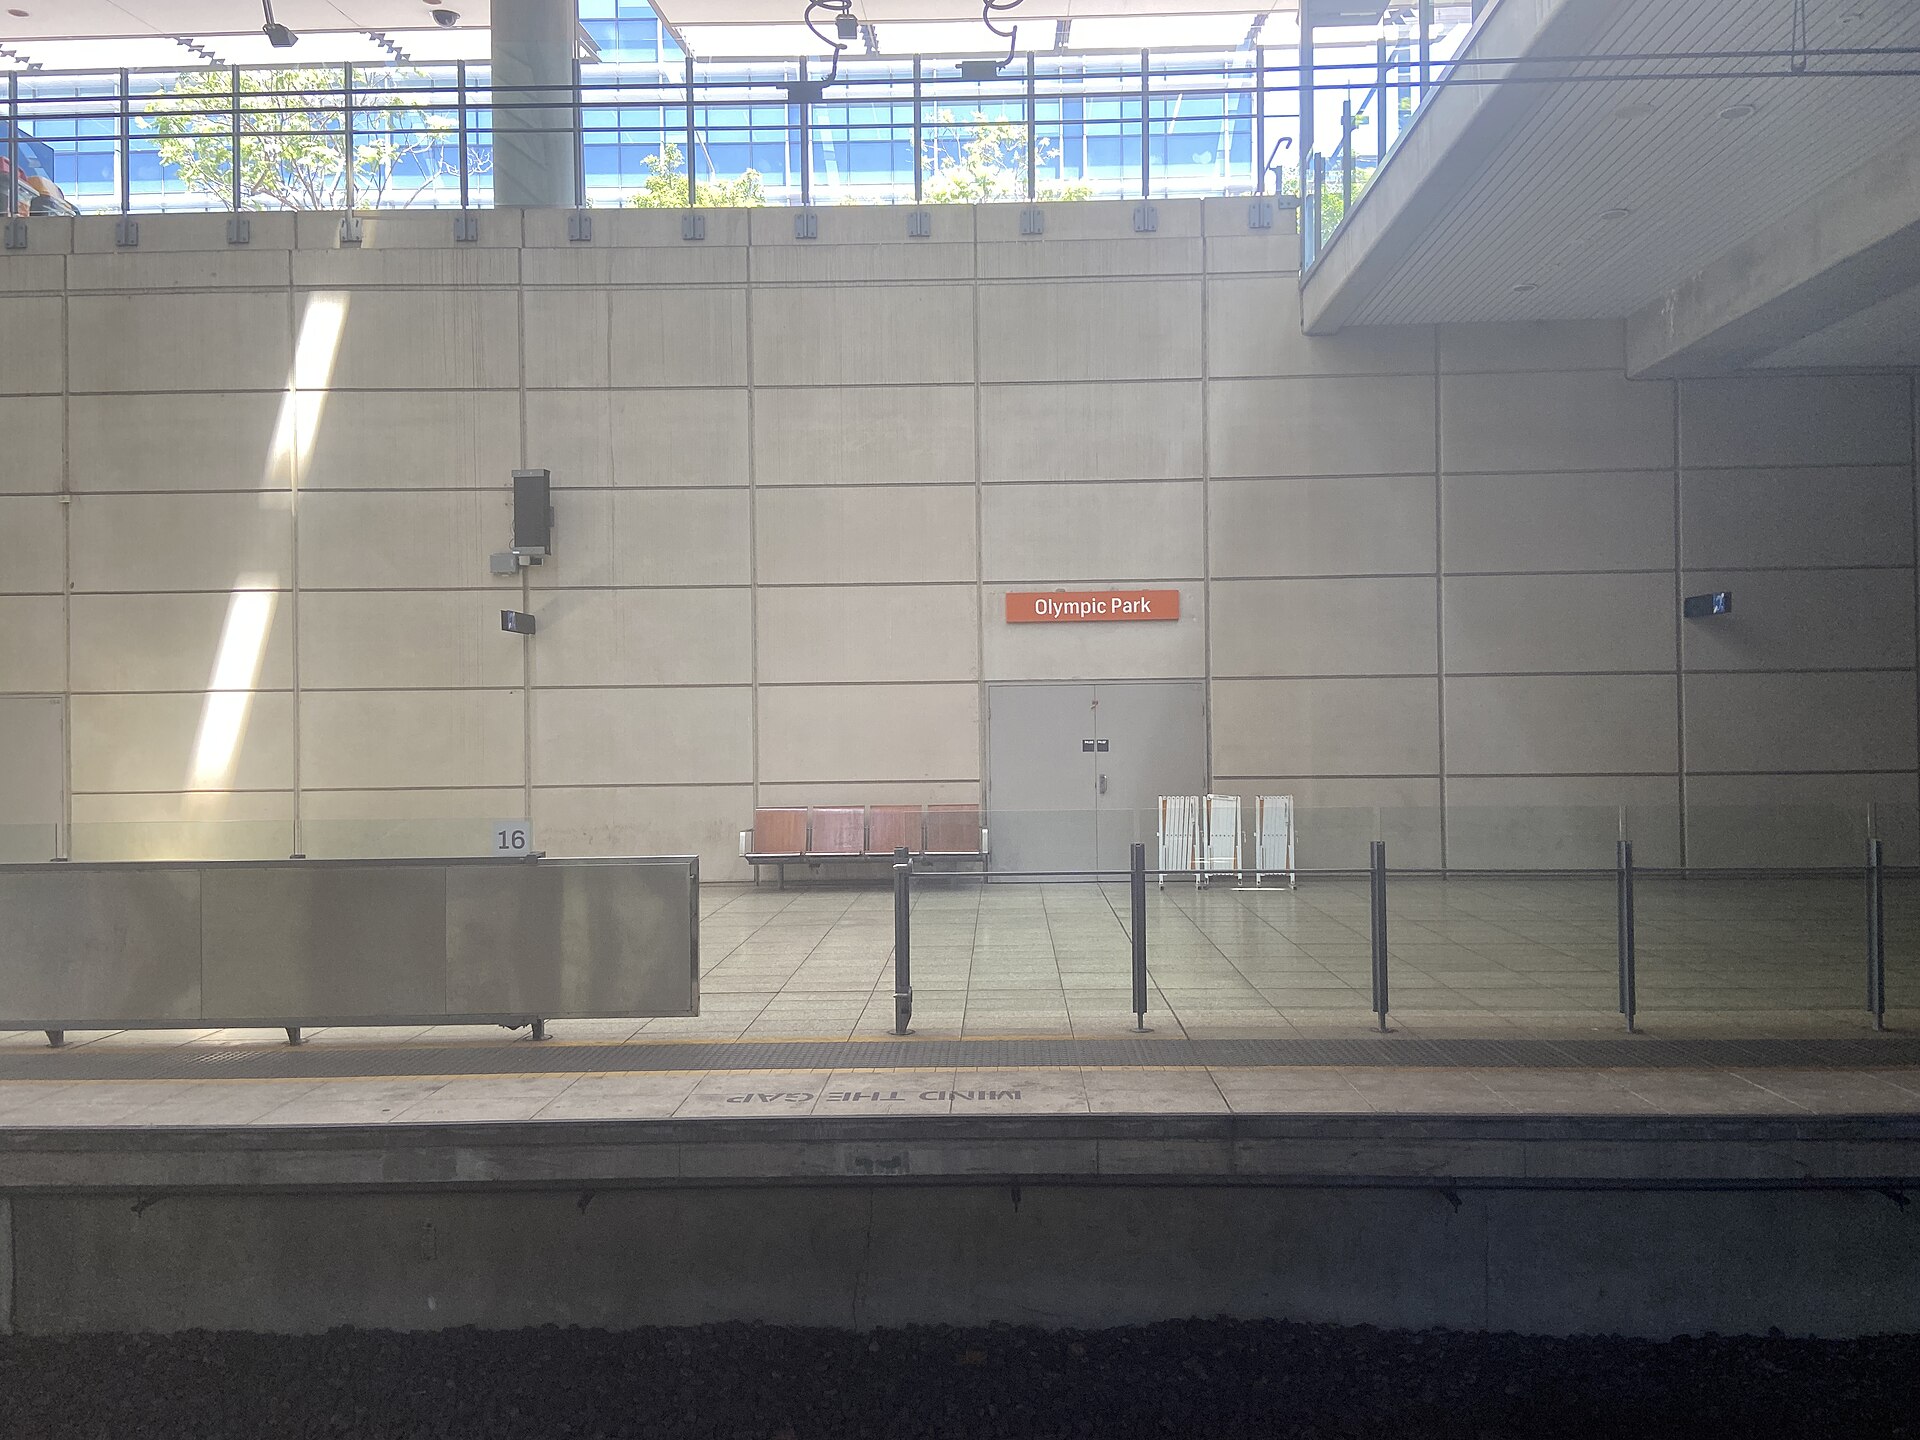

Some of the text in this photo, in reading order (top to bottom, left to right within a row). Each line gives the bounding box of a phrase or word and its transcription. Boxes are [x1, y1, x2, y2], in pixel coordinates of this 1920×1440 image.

[1035, 597, 1151, 618] Olympic Park
[498, 830, 526, 849] 16
[726, 1090, 1021, 1103] MIND THE GAP
